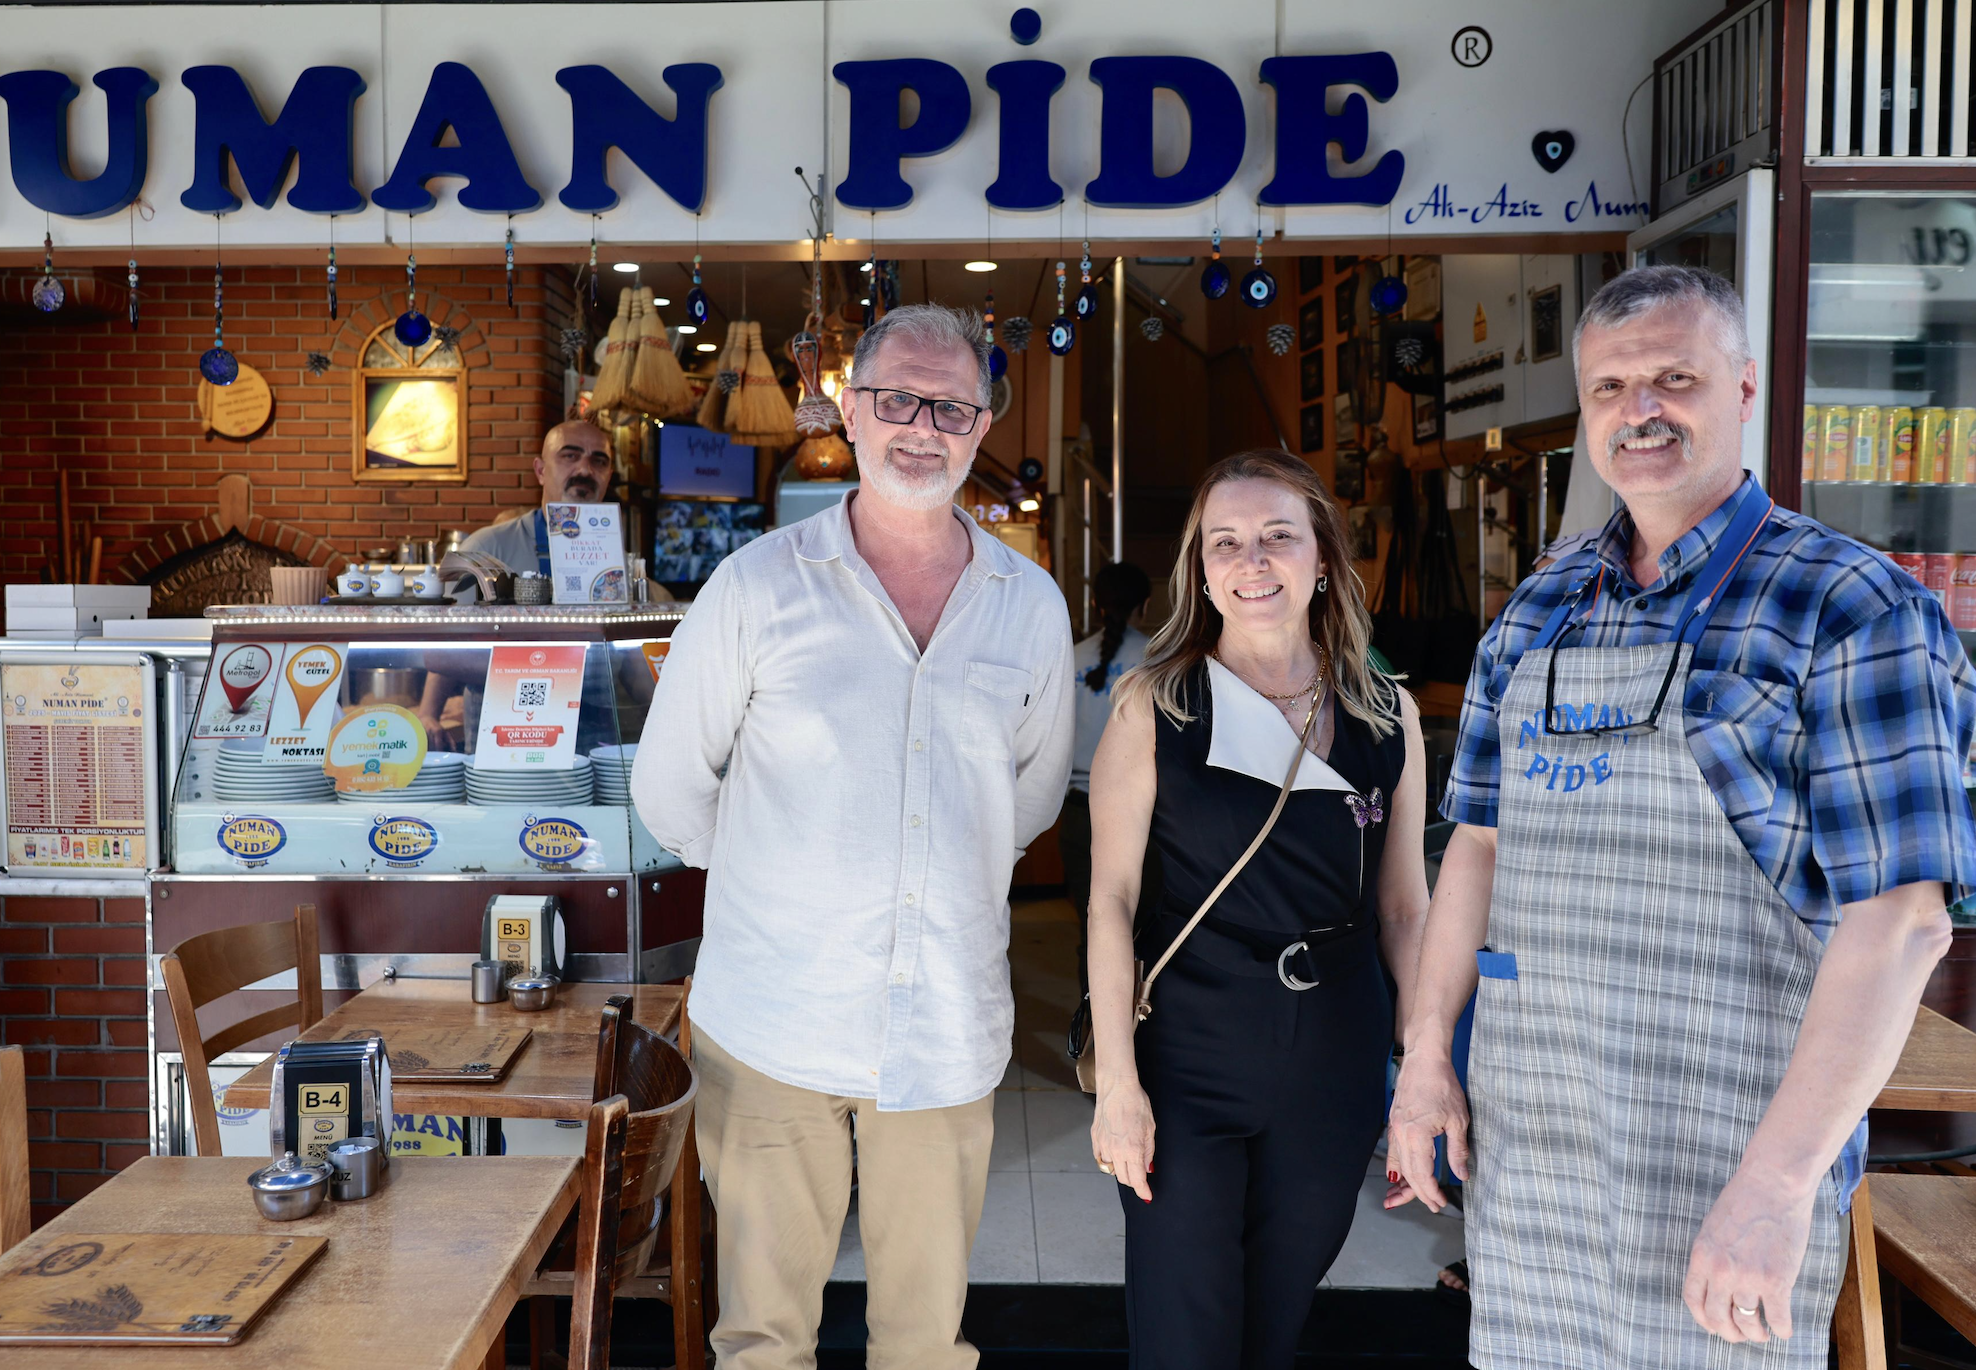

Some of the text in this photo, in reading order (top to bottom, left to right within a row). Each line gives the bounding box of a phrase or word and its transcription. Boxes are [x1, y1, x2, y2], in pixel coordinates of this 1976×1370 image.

[0, 7, 1405, 219] UMAN PİDE
[1404, 183, 1543, 224] Ali-Aziz
[565, 552, 610, 560] LEZZET
[226, 670, 261, 678] Metropol
[42, 698, 104, 708] NUMAN PİDE
[249, 724, 262, 732] 83
[1518, 703, 1633, 749] NUMAN
[270, 737, 306, 745] LEZZET
[508, 731, 520, 739] QR
[282, 748, 325, 756] NOKTASI
[342, 740, 408, 753] yemekmatik
[1524, 752, 1613, 792] PİDE
[229, 822, 275, 838] NUMAN
[380, 824, 426, 839] NUMAN
[531, 825, 577, 841] NUMAN
[234, 839, 270, 853] PİDE
[385, 841, 422, 854] PİDE
[535, 842, 572, 856] PİDE
[503, 923, 525, 935] B-3
[306, 1091, 341, 1108] B-4
[393, 1114, 463, 1142] MAN
[393, 1141, 422, 1150] 988
